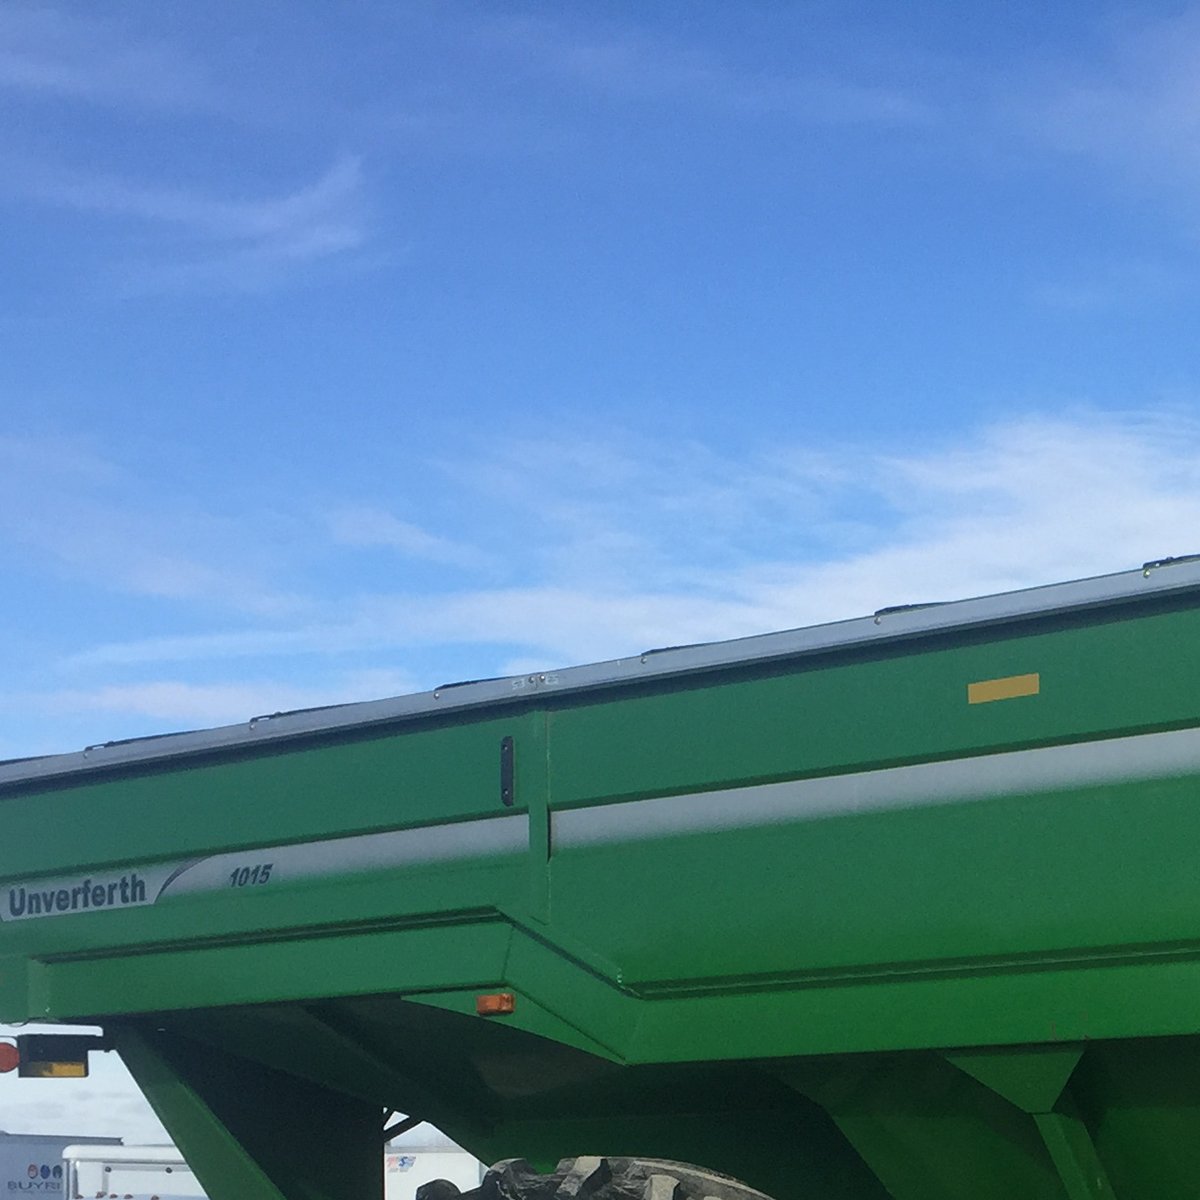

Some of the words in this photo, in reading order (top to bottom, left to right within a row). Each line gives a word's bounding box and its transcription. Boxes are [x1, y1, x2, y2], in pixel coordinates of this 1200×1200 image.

[9, 873, 146, 917] Unverferth
[230, 863, 274, 887] 1015
[7, 1180, 61, 1190] BUYRI
